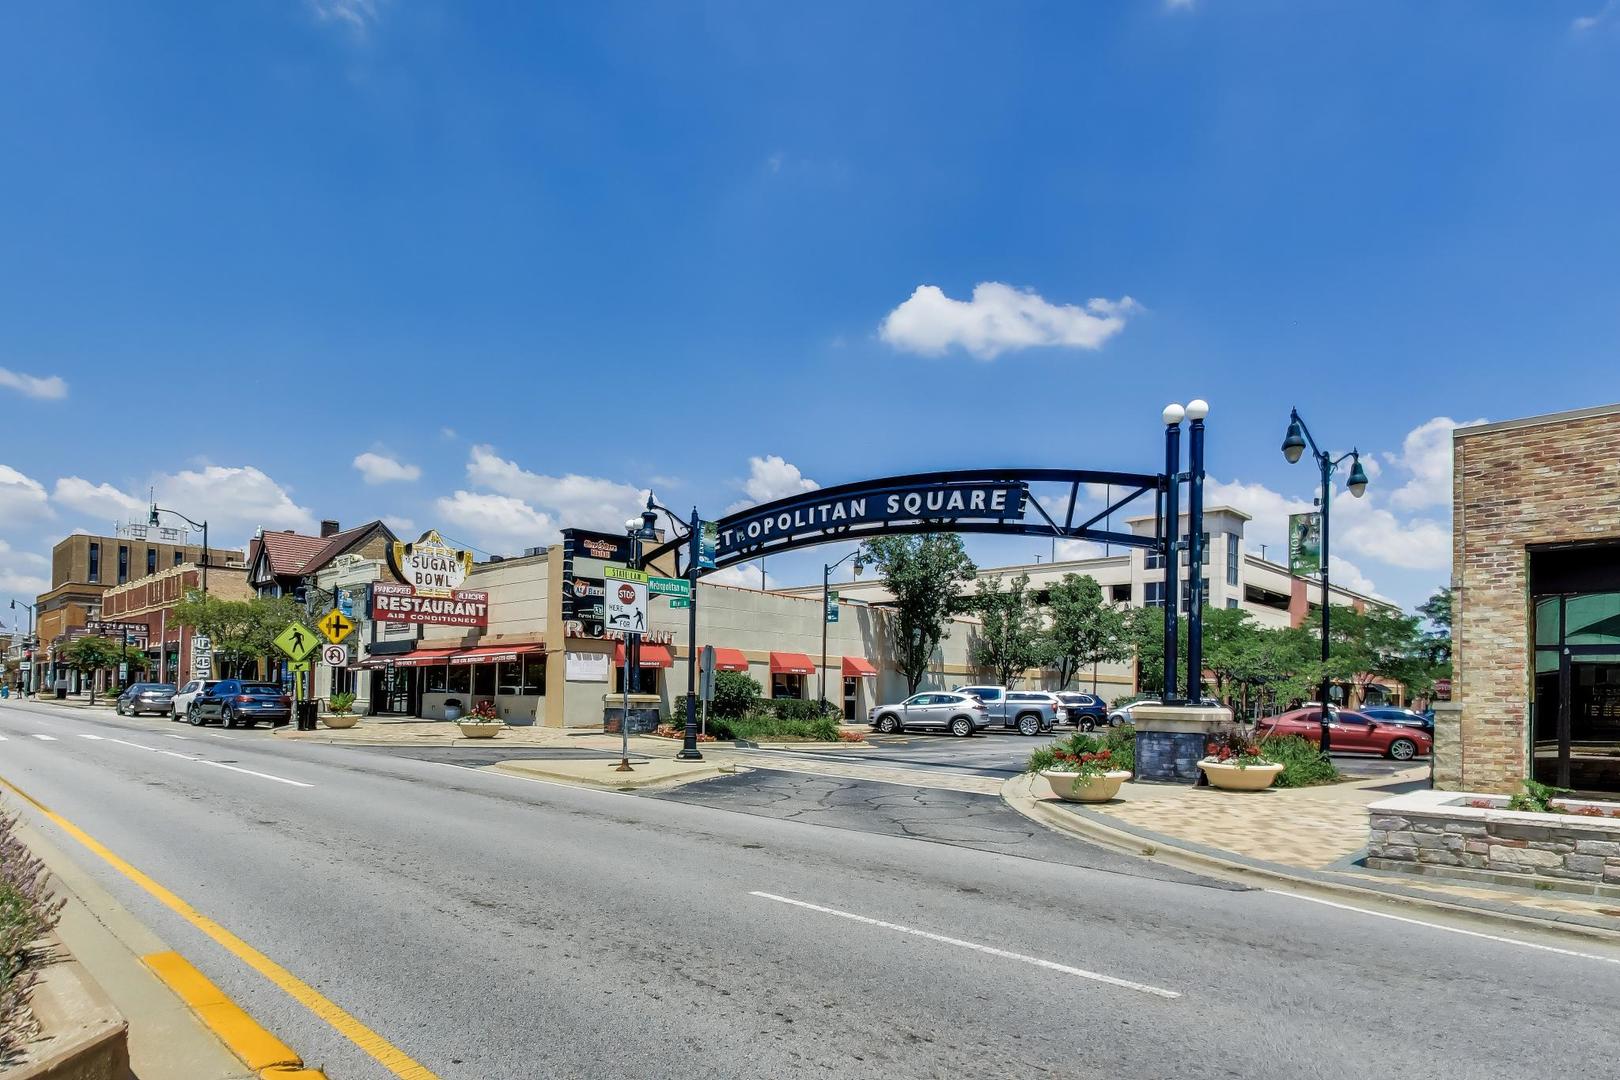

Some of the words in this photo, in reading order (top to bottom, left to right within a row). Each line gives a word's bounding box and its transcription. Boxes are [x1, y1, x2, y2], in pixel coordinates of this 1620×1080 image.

[886, 489, 1007, 515] SQUARE
[411, 556, 456, 573] SUGAR
[612, 568, 630, 578] STATE
[415, 572, 452, 587] BOWL
[649, 580, 680, 592] Metropolitan
[619, 590, 635, 599] STOP
[376, 595, 486, 617] RESTAURANT
[609, 604, 624, 613] HERE
[410, 614, 477, 624] CONDITIONED
[620, 620, 630, 628] FOR
[197, 659, 210, 667] 45
